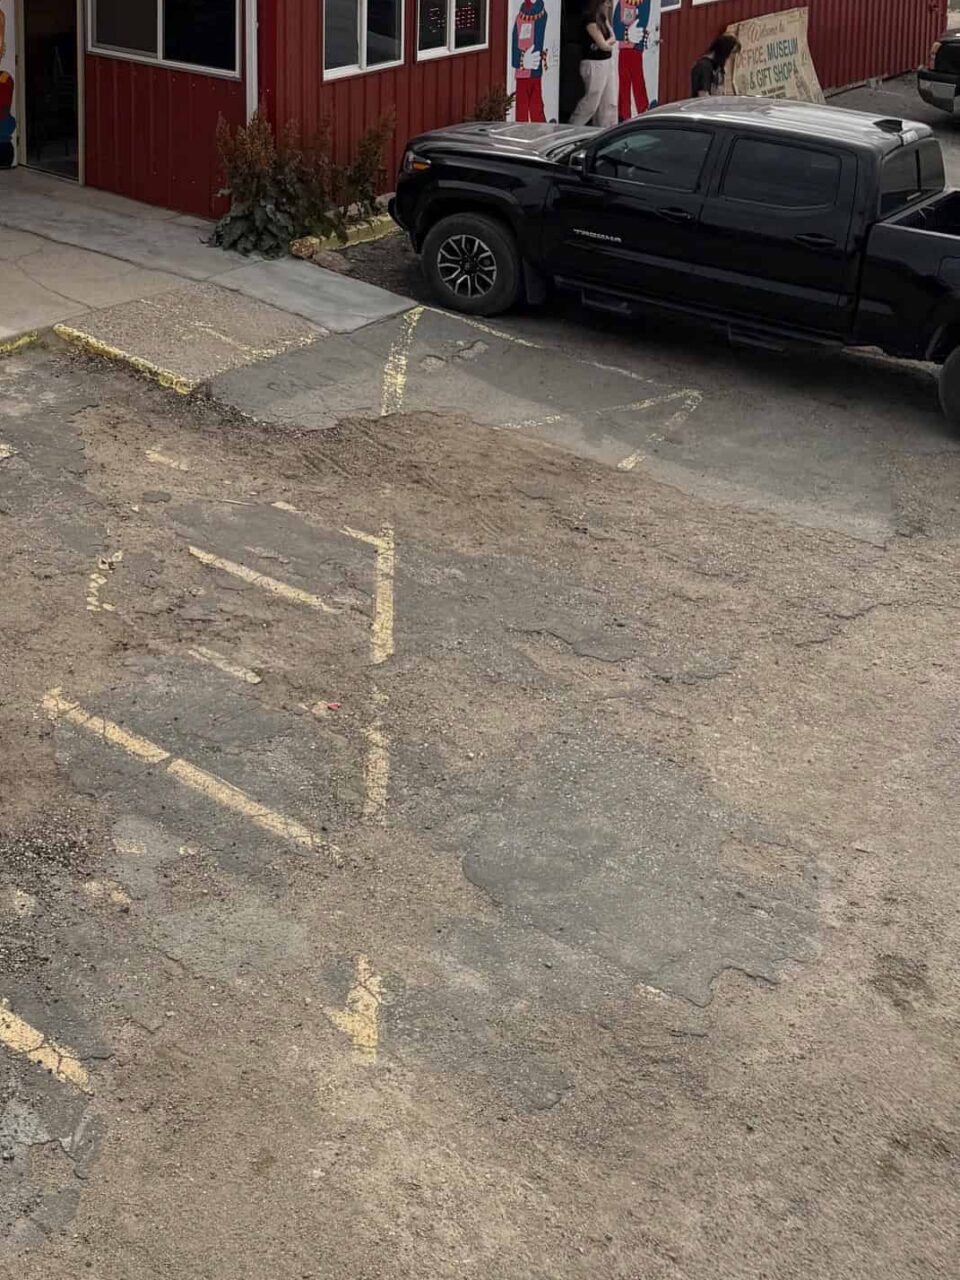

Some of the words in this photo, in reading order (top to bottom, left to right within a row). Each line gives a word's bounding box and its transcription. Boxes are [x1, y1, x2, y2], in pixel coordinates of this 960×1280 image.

[767, 36, 799, 61] MUSEUM
[756, 66, 773, 88] GIFT
[573, 228, 622, 242] TACOMA
